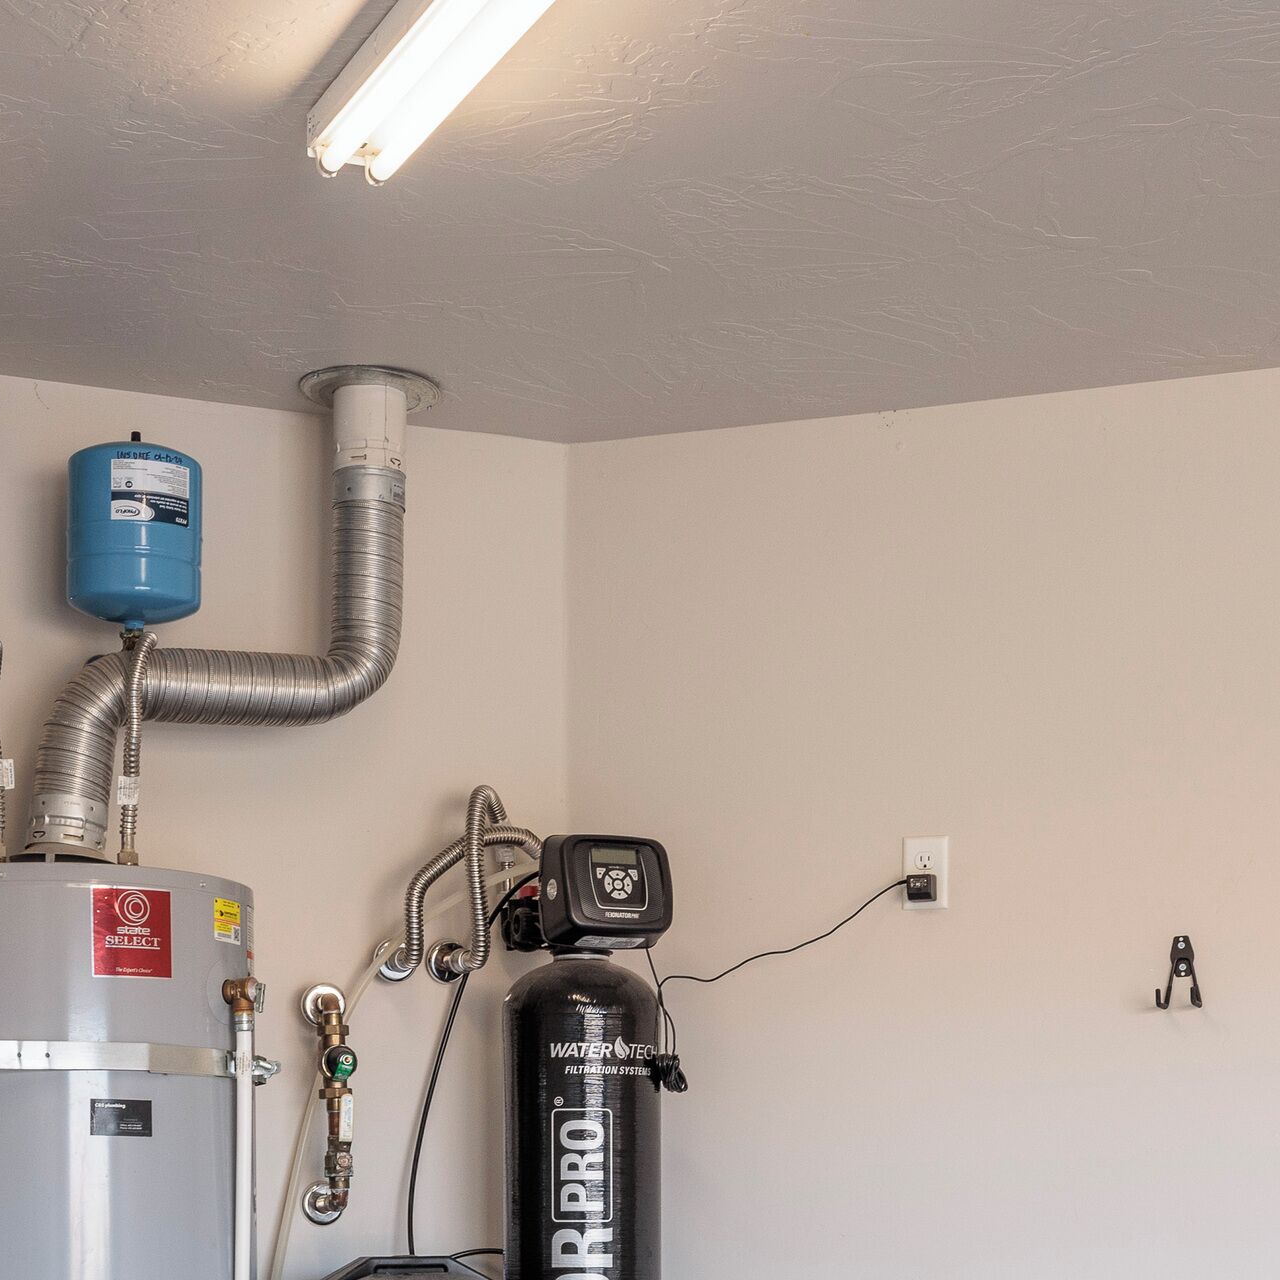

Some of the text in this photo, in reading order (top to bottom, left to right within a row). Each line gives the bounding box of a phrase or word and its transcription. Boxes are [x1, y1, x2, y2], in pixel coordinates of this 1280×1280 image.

[116, 926, 151, 936] state
[104, 935, 160, 947] SELECT
[550, 1042, 658, 1060] WATER TECH
[565, 1065, 652, 1076] FILTRATION SYSTEMS
[560, 1119, 605, 1213] PRO
